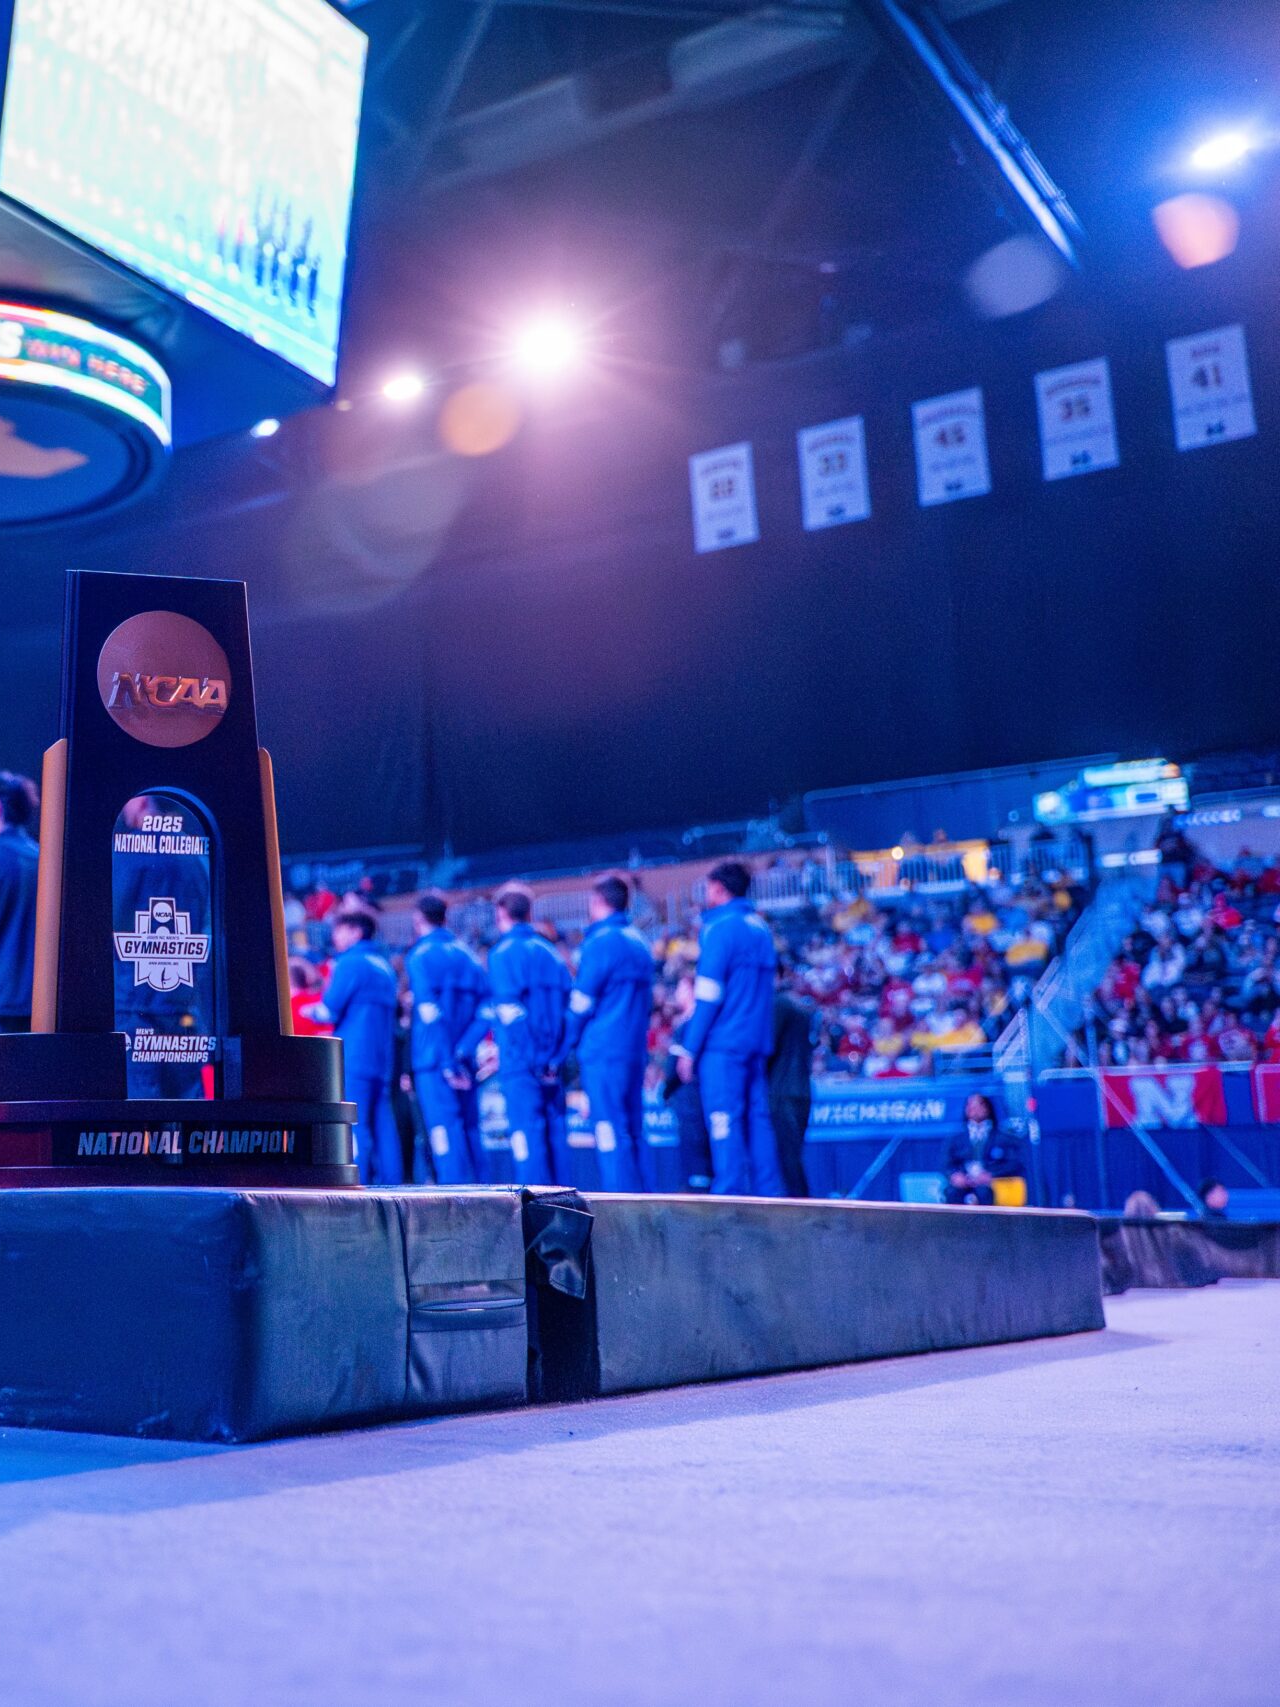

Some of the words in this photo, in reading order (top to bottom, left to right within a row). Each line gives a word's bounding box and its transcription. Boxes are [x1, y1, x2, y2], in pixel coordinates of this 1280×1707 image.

[108, 671, 227, 714] NCAA
[141, 815, 183, 832] 2025
[114, 833, 157, 854] NATIONAL
[158, 836, 210, 855] COLLEGIATE
[124, 940, 204, 955] GYMNASTICS
[133, 1036, 216, 1051] GYMNASTICS
[131, 1052, 209, 1063] CHAMPIONSHIPS
[813, 1099, 946, 1124] MICHIGAN
[1127, 1075, 1198, 1128] N
[77, 1131, 182, 1156] NATIONAL
[188, 1130, 295, 1154] CHAMPION
